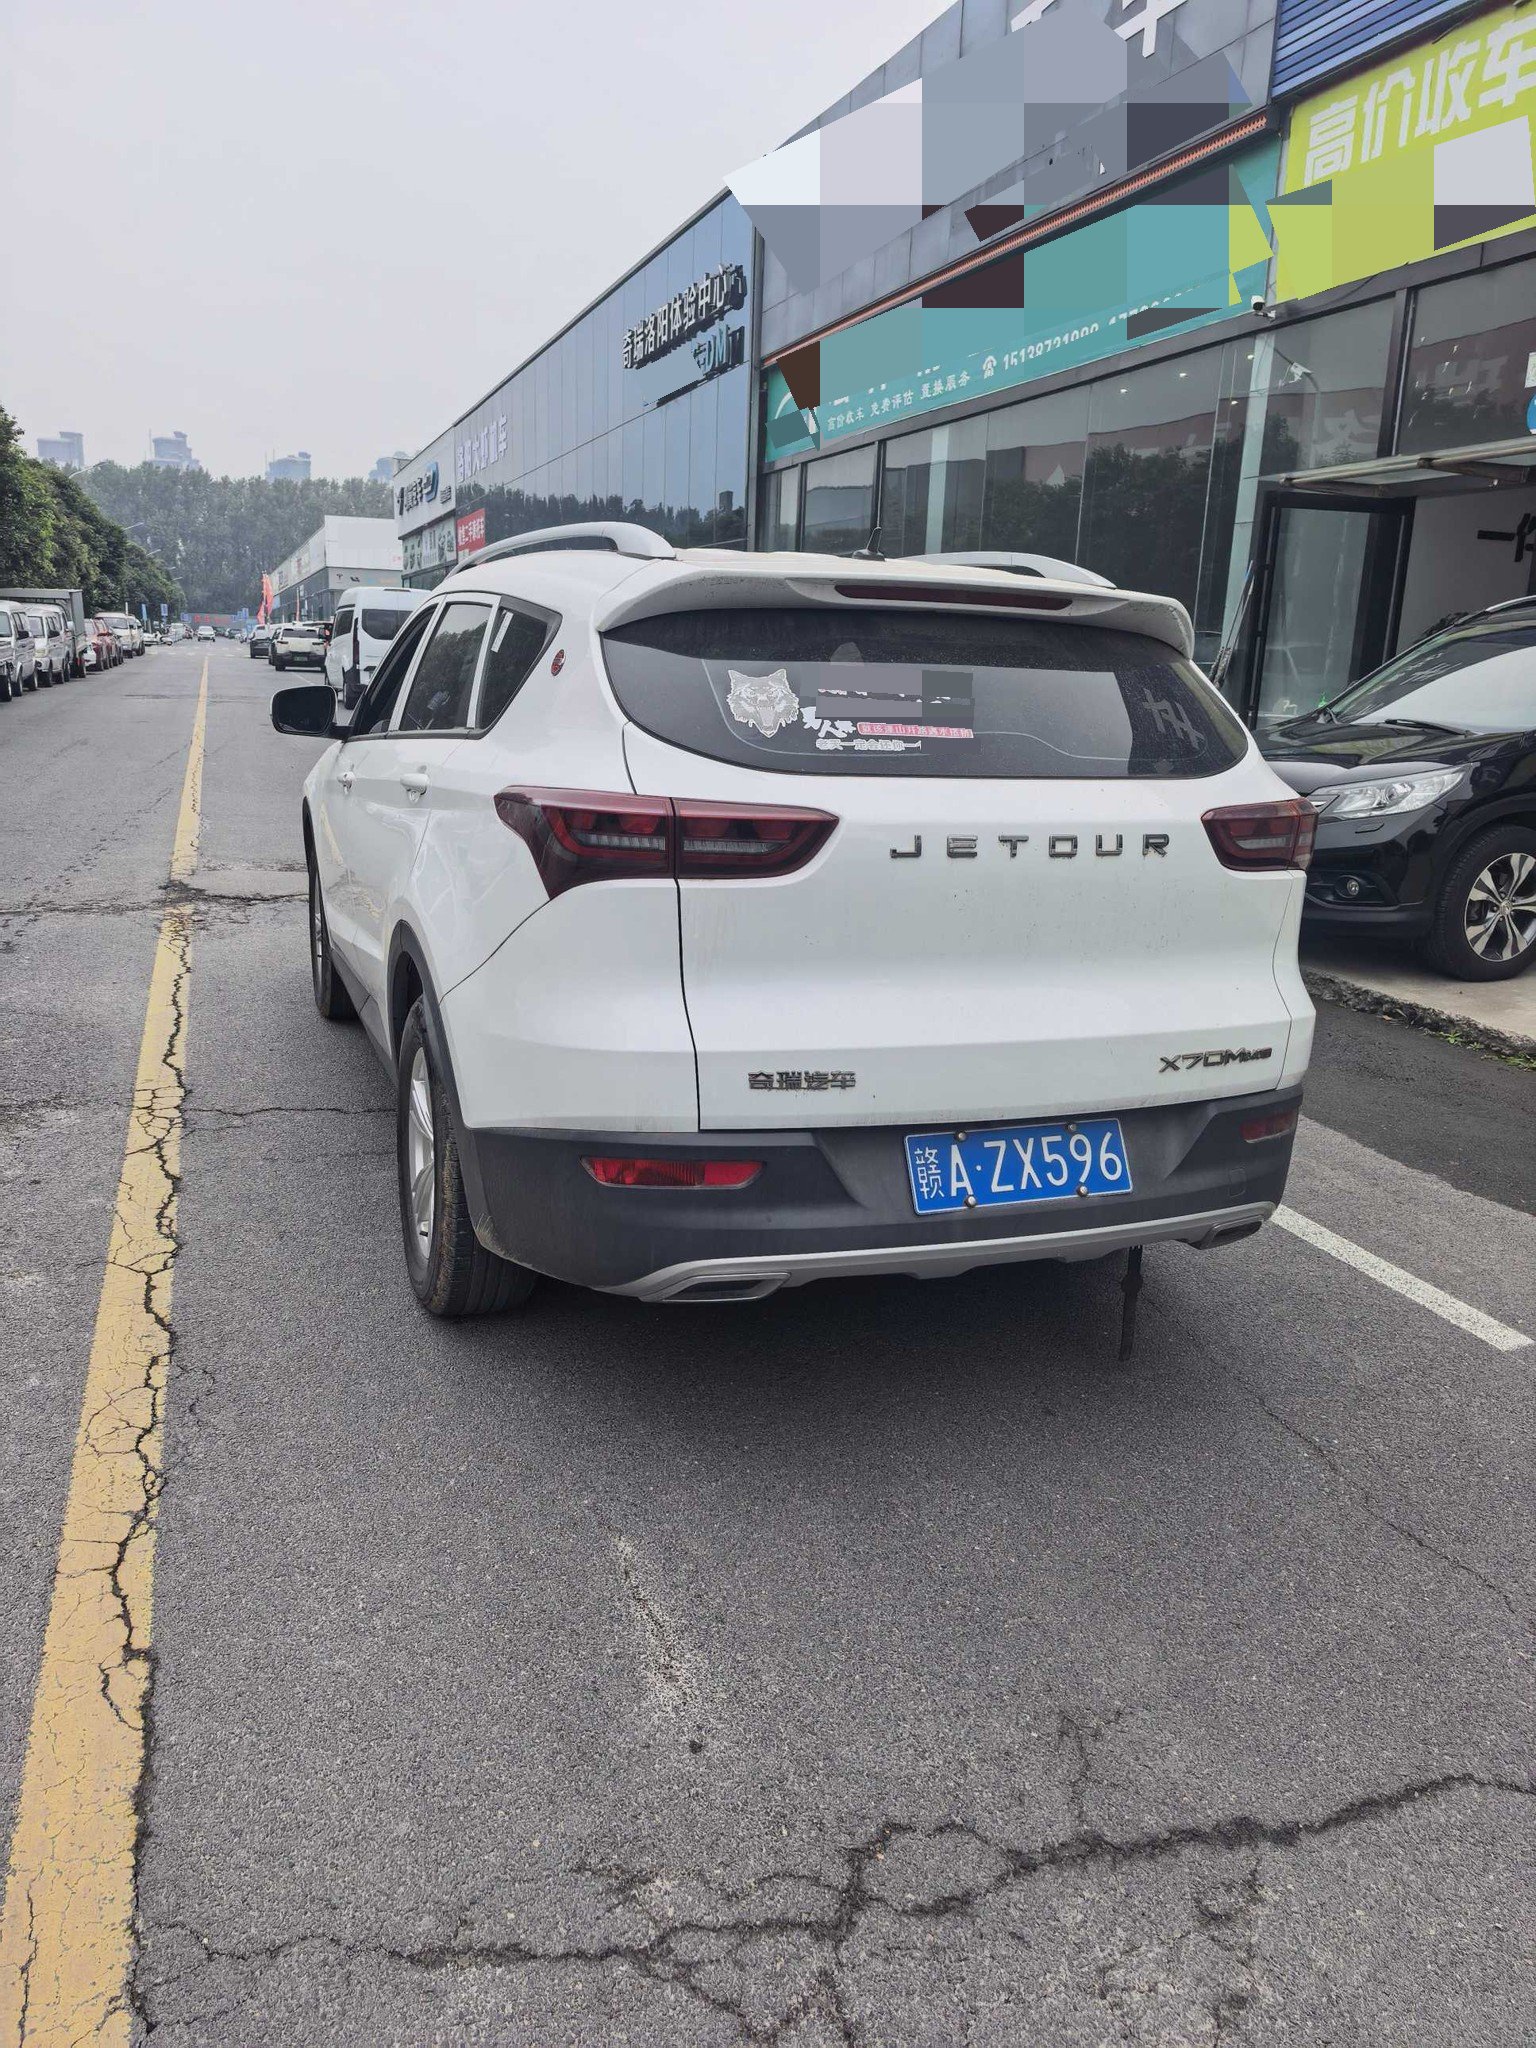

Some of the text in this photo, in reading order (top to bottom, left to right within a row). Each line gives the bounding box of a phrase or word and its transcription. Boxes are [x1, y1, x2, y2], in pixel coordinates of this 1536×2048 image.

[1304, 14, 1536, 188] 高价收车
[870, 389, 914, 418] 免费评估
[889, 834, 1170, 858] JETOUR
[748, 1071, 856, 1090] 奇瑞汽车
